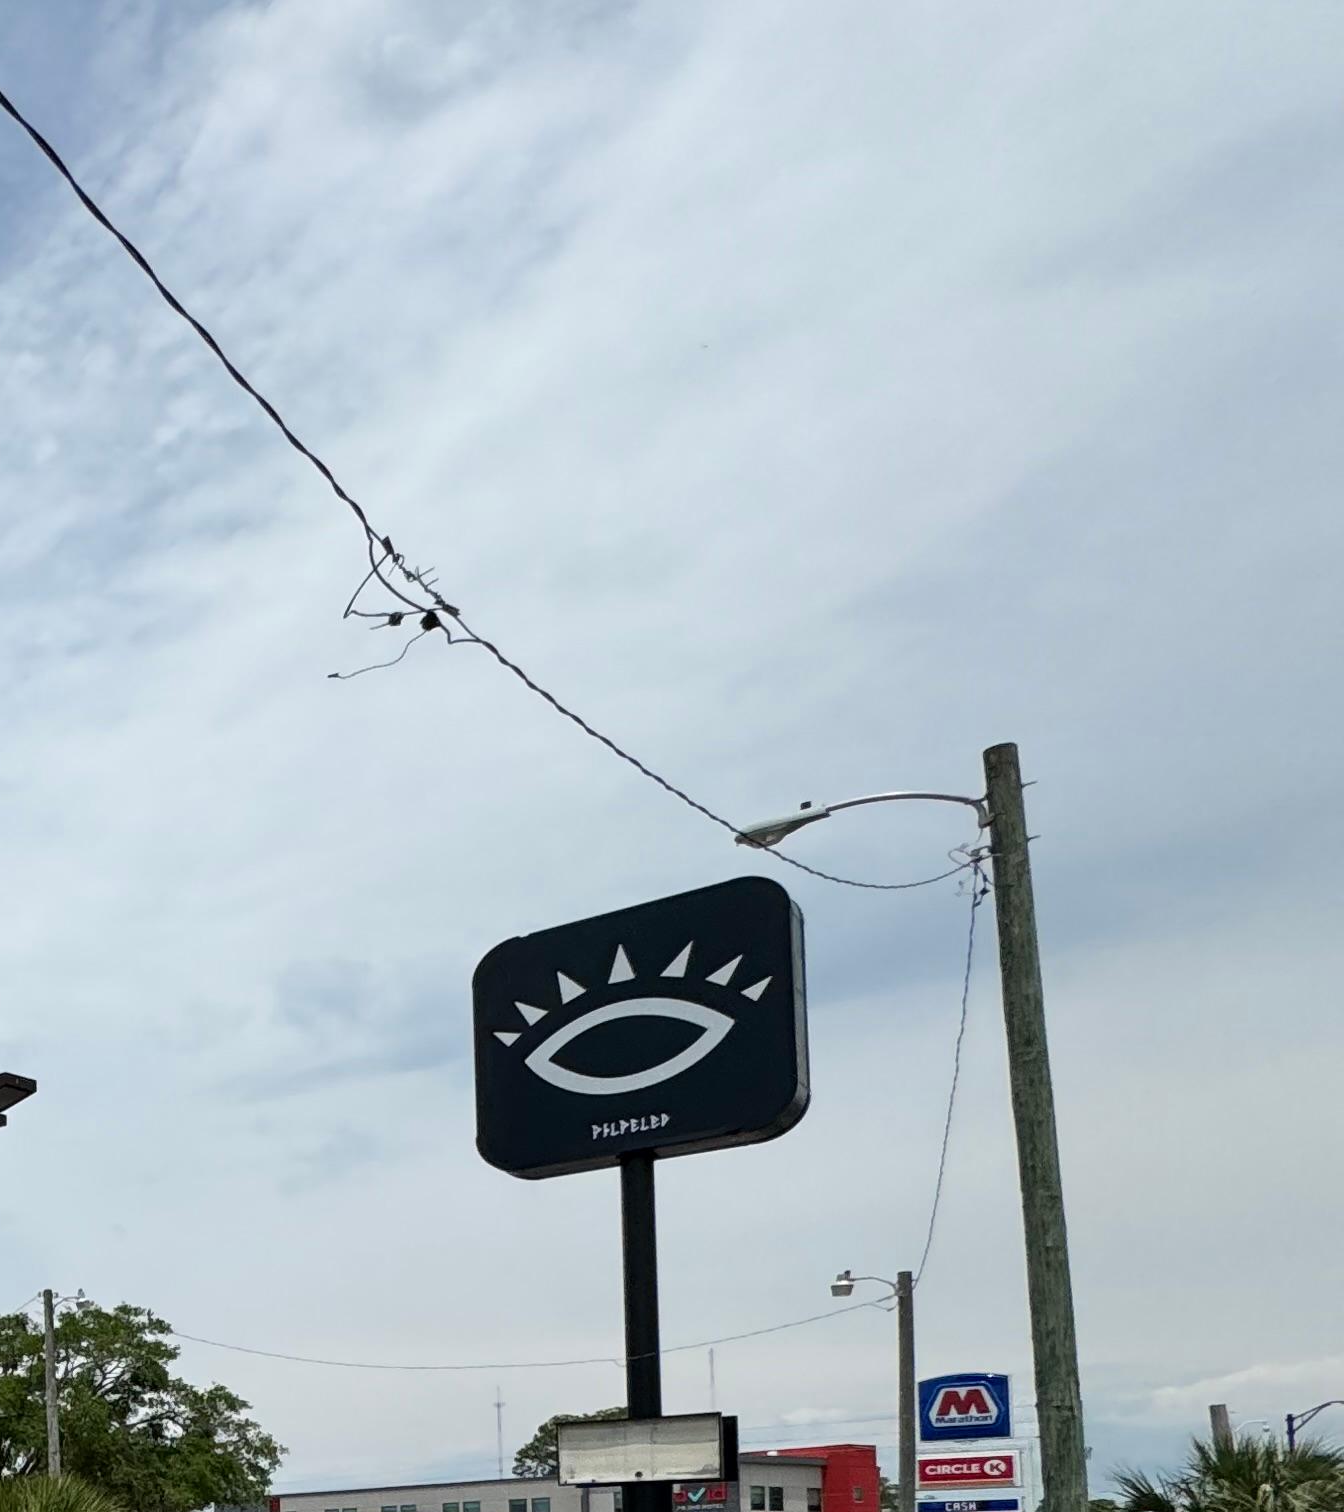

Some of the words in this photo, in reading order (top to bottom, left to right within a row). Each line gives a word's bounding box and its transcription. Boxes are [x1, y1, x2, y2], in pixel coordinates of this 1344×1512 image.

[935, 1415, 993, 1424] Marathon
[924, 1463, 982, 1476] CIRCLE
[986, 1461, 1005, 1474] K
[944, 1502, 977, 1512] CASH
